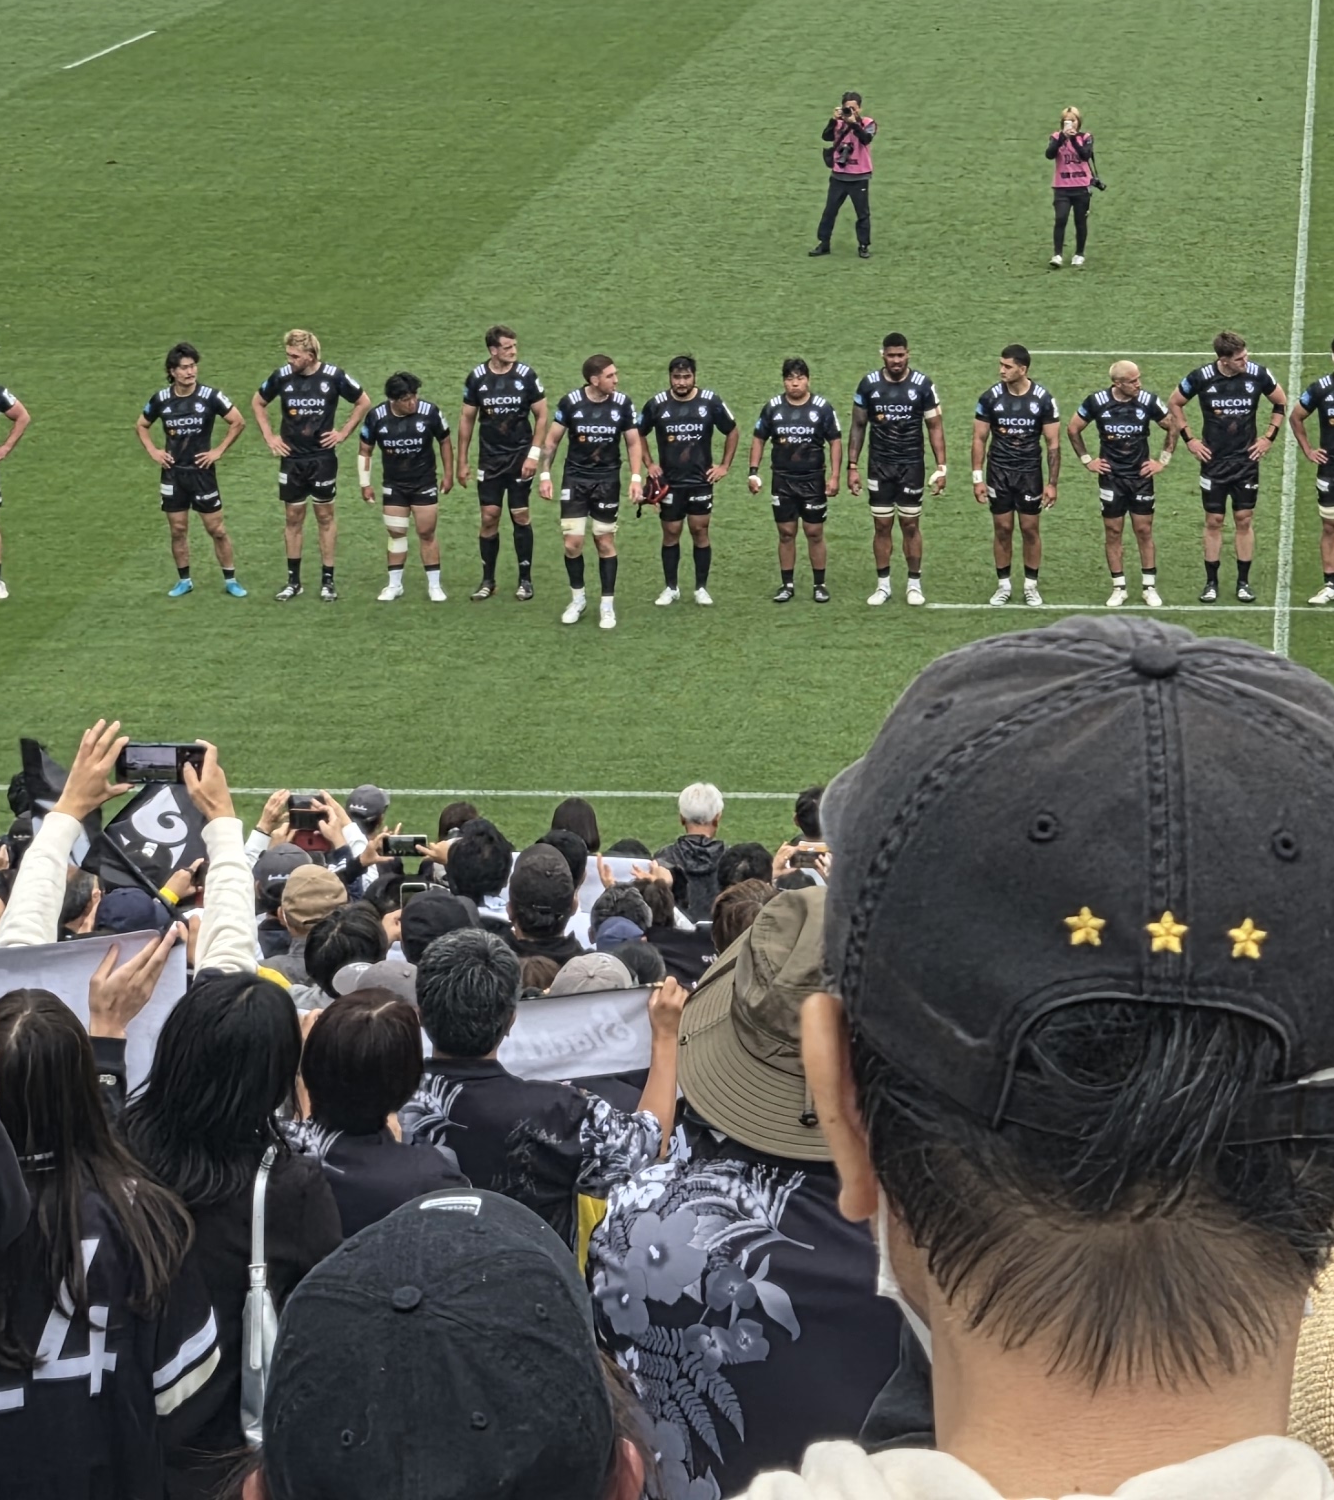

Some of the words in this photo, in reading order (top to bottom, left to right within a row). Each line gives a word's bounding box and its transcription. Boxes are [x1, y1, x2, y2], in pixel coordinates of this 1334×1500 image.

[288, 398, 325, 407] RICOH
[483, 396, 522, 406] RICOH
[1211, 398, 1252, 407] RICOH
[875, 404, 913, 413] RICOH
[165, 417, 203, 427] RICOH
[998, 417, 1036, 426] RICOH
[577, 425, 617, 434] RICOH
[665, 423, 704, 433] RICOH
[777, 426, 815, 435] RICOH
[1104, 424, 1143, 433] RICOH
[383, 437, 423, 447] RICOH
